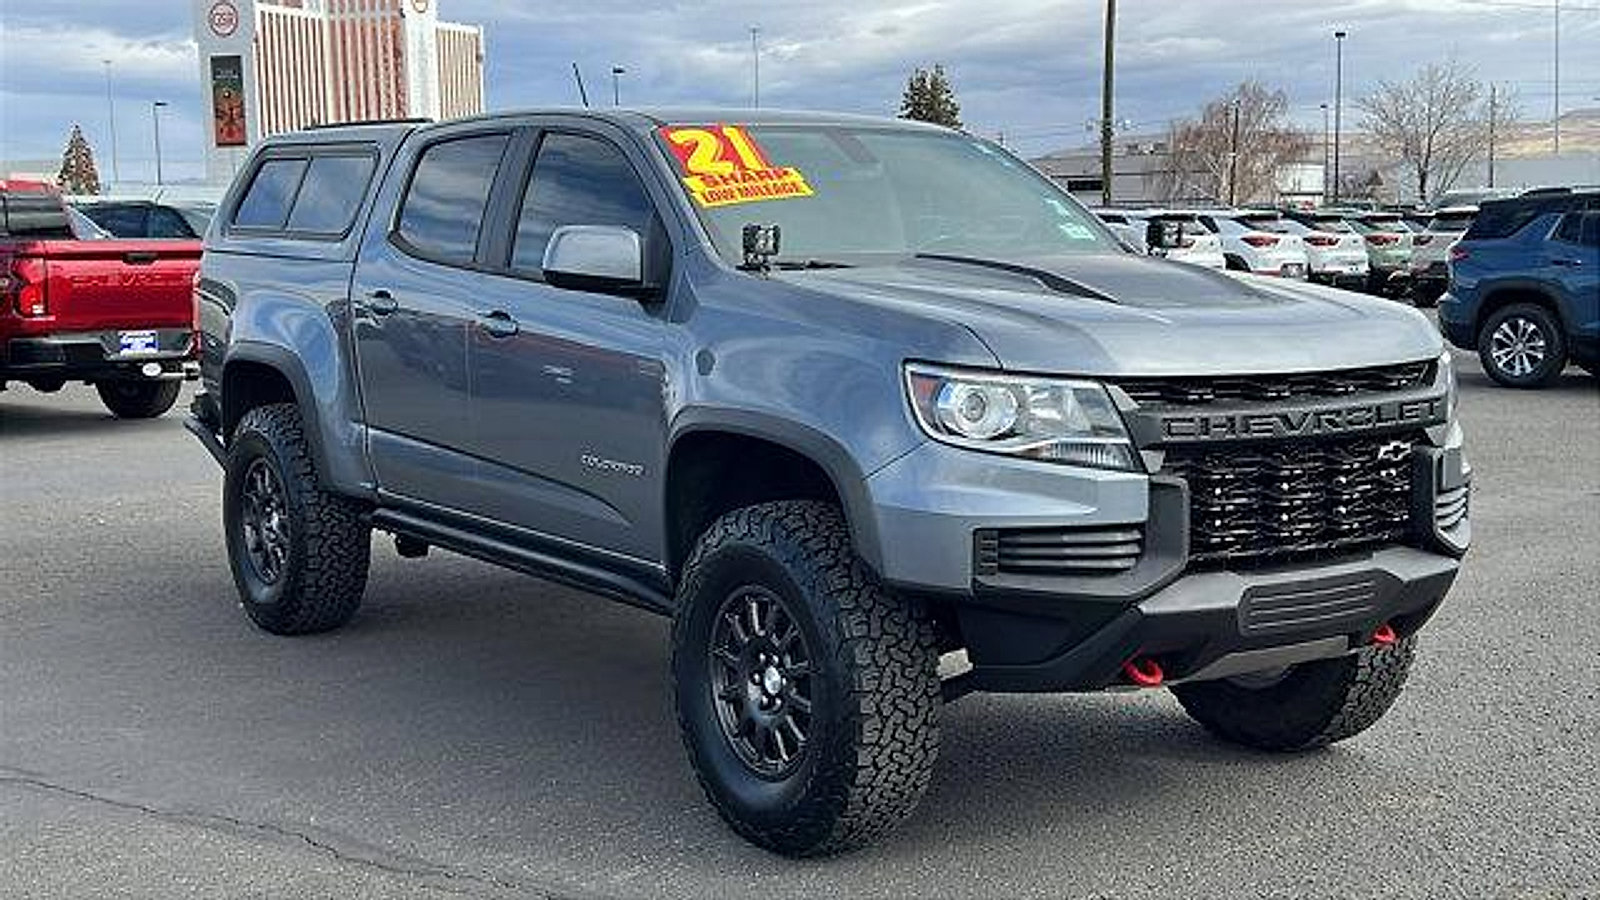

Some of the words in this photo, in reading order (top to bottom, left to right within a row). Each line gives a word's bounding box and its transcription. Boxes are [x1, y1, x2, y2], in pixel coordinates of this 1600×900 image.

[669, 126, 766, 174] 21
[700, 168, 789, 186] SHARP
[702, 187, 736, 203] LOW
[737, 181, 800, 198] MILEAGE
[72, 273, 191, 288] CHEVR
[1161, 397, 1442, 442] CHEVROLET
